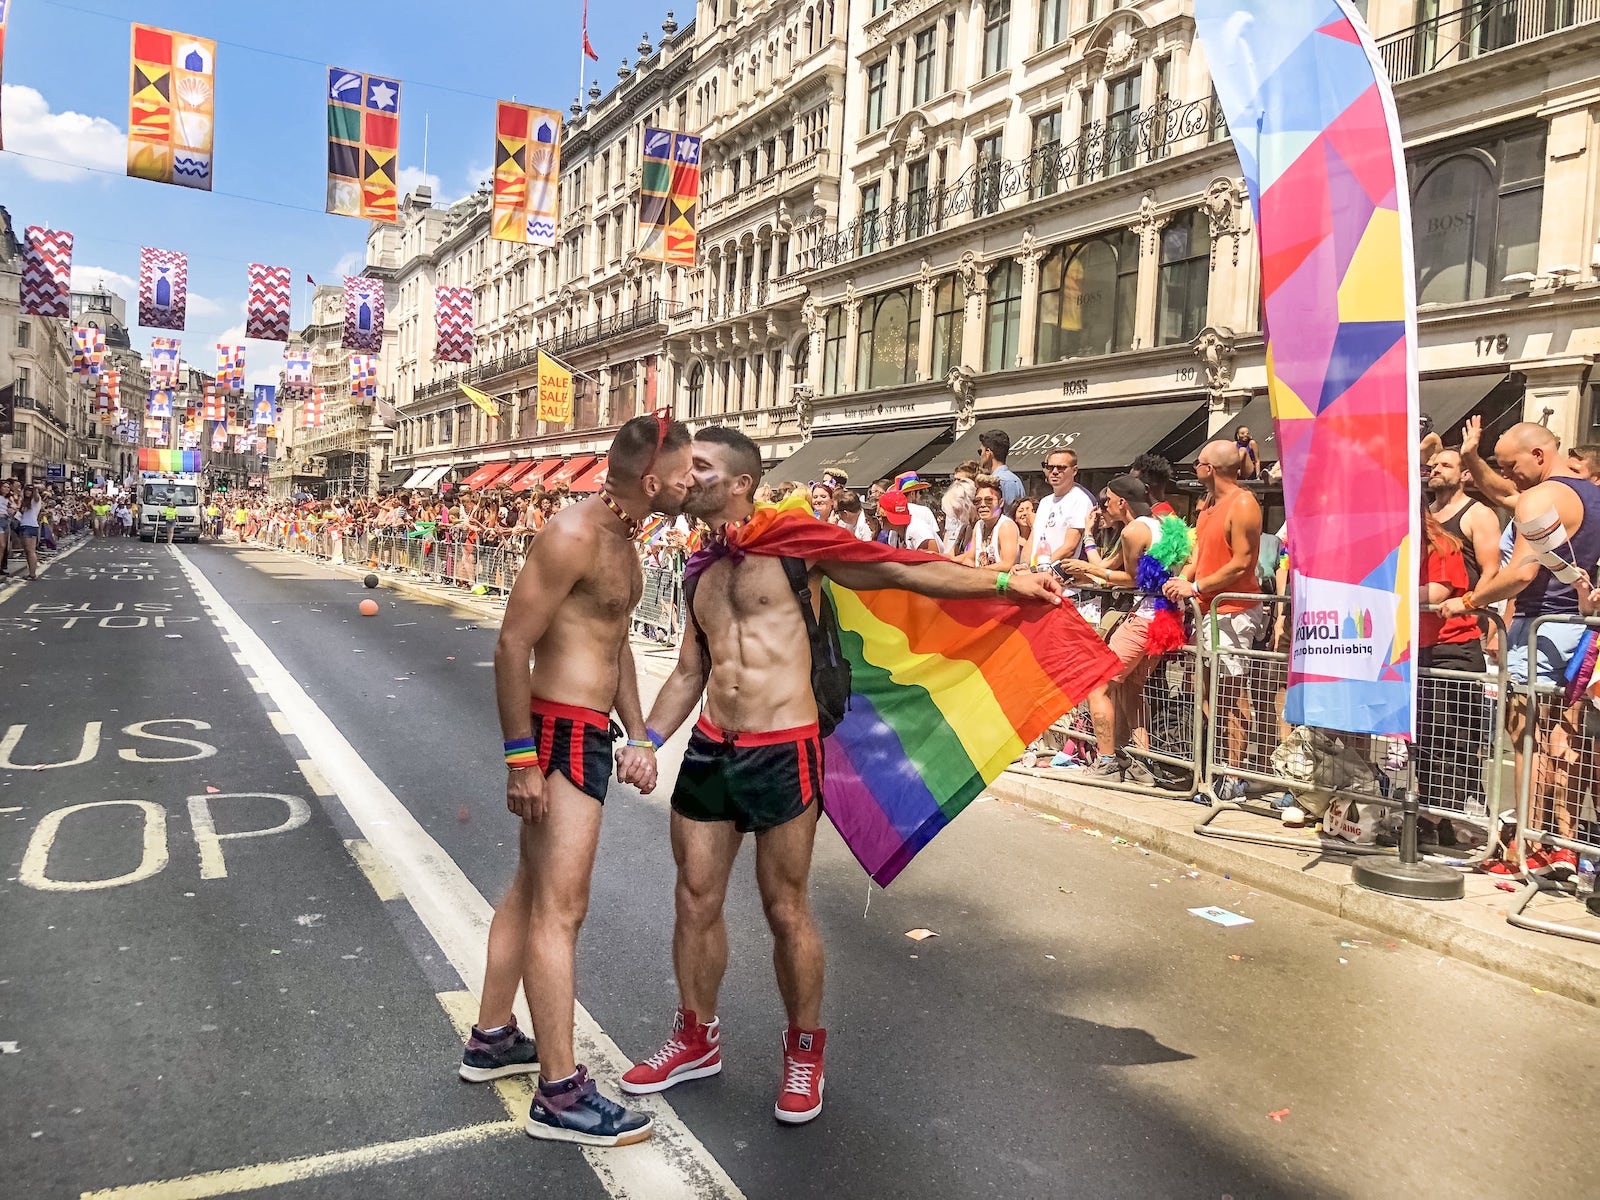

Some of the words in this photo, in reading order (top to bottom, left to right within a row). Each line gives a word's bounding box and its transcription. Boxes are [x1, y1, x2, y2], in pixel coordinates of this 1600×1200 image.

[1427, 210, 1475, 233] BOSS
[1076, 290, 1102, 306] BOSS
[1475, 334, 1509, 357] 178
[541, 376, 569, 388] SALE
[1175, 367, 1195, 382] 180
[1063, 379, 1088, 395] BOSS
[540, 391, 568, 402] SALE
[540, 405, 569, 417] SALE
[1009, 432, 1081, 451] BOSS
[24, 602, 173, 613] BUS
[0, 615, 200, 629] STOP
[1341, 822, 1362, 836] RING
[0, 793, 311, 891] OP
